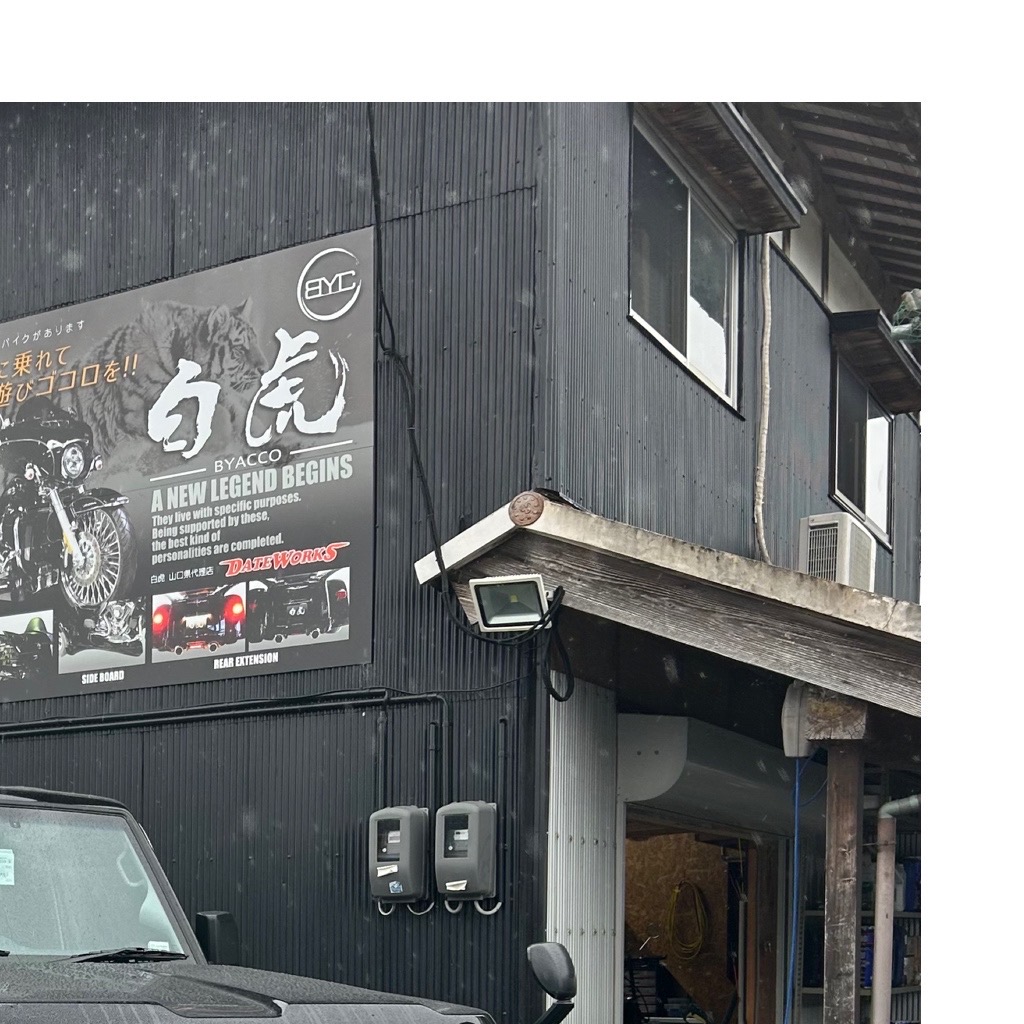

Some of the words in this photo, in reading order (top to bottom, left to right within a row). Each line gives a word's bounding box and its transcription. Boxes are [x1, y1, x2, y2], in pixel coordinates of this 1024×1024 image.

[147, 327, 350, 459] 白虎
[214, 449, 282, 473] BYACCO
[151, 489, 163, 513] A
[167, 480, 207, 510] NEW
[210, 467, 277, 502] LEGEND
[282, 454, 353, 490] BEGINS
[152, 513, 173, 528] They
[174, 510, 191, 523] live
[192, 505, 213, 520] with
[214, 499, 252, 517] specific
[253, 491, 301, 510] purposes.
[152, 526, 177, 540] Being
[179, 517, 226, 537] supported
[228, 514, 239, 528] by
[240, 510, 270, 525] these,
[151, 540, 167, 552] the
[168, 536, 189, 549] best
[189, 531, 210, 546] kind
[211, 529, 221, 542] of
[151, 546, 212, 566] personalities
[213, 543, 230, 554] are
[230, 532, 284, 552] completed.
[213, 657, 234, 670] REAR
[235, 652, 279, 668] EXTENSION
[81, 672, 98, 685] SIDE
[99, 669, 125, 682] BOARD
